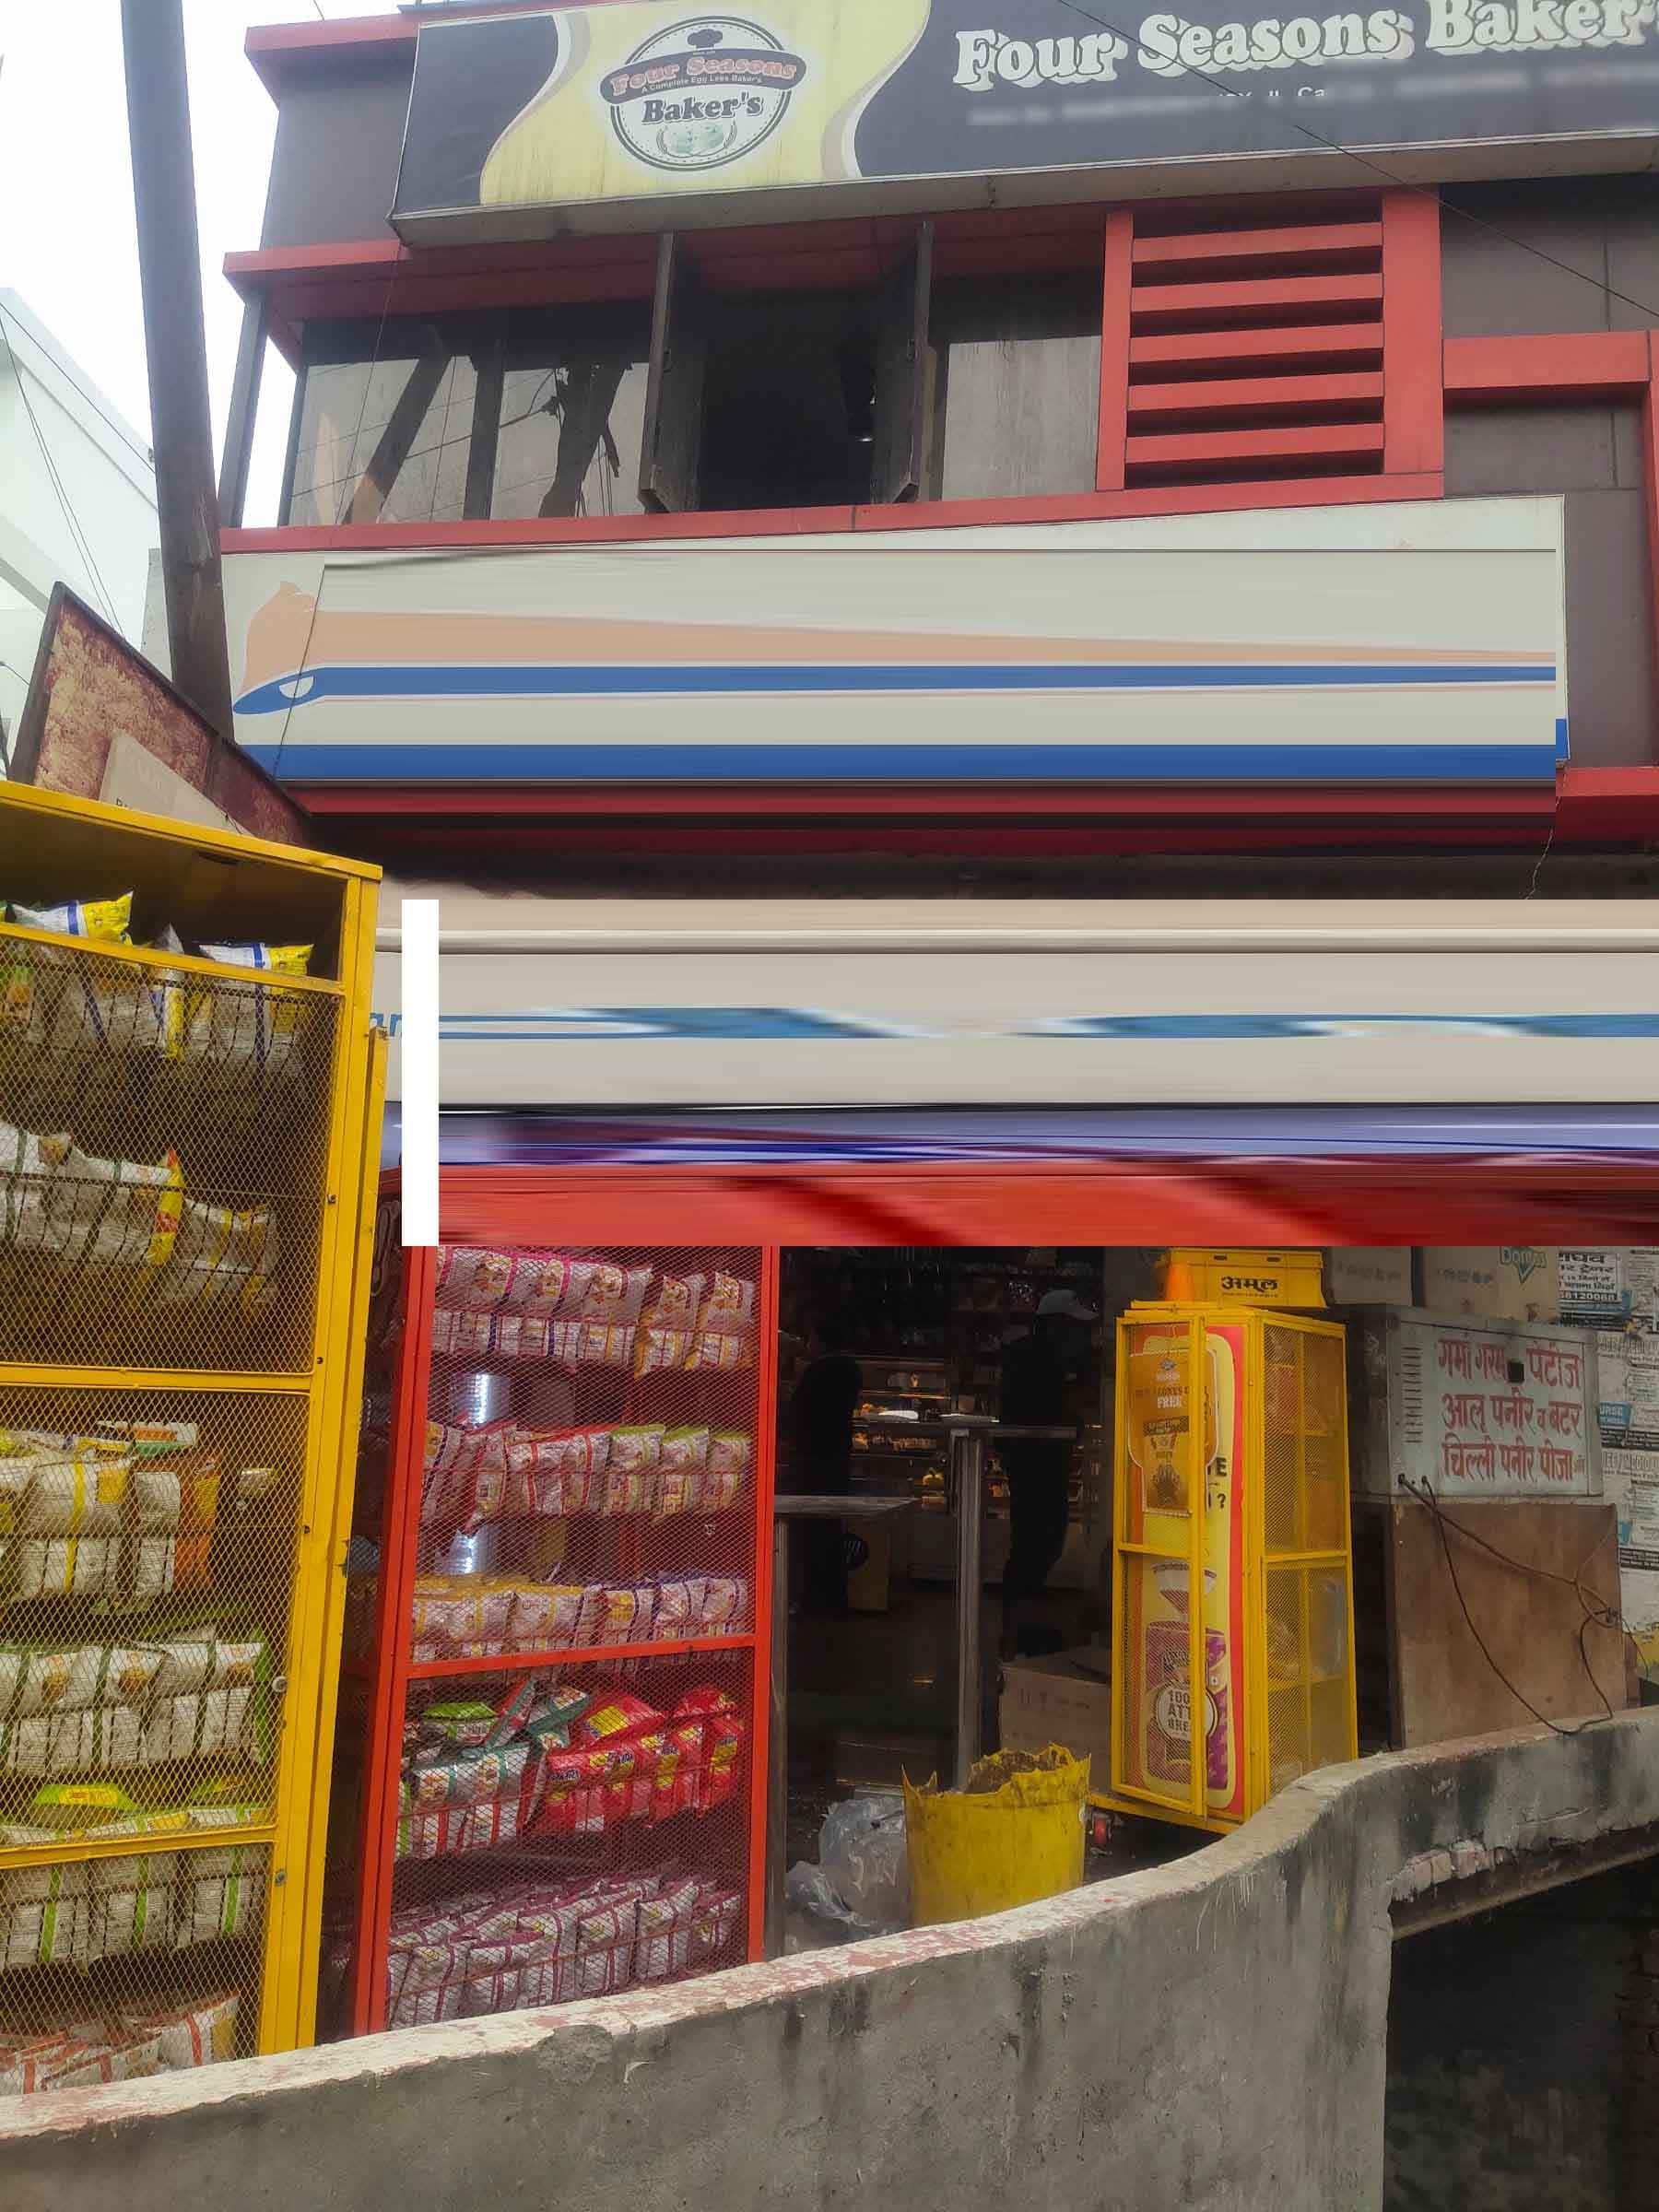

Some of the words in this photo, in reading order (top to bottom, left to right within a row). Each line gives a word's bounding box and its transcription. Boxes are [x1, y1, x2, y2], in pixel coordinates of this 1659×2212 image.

[952, 29, 1128, 91] Four
[1137, 8, 1415, 77] Seasons
[610, 63, 680, 96] Four
[686, 56, 797, 79] Seasons
[641, 90, 765, 125] Baker's
